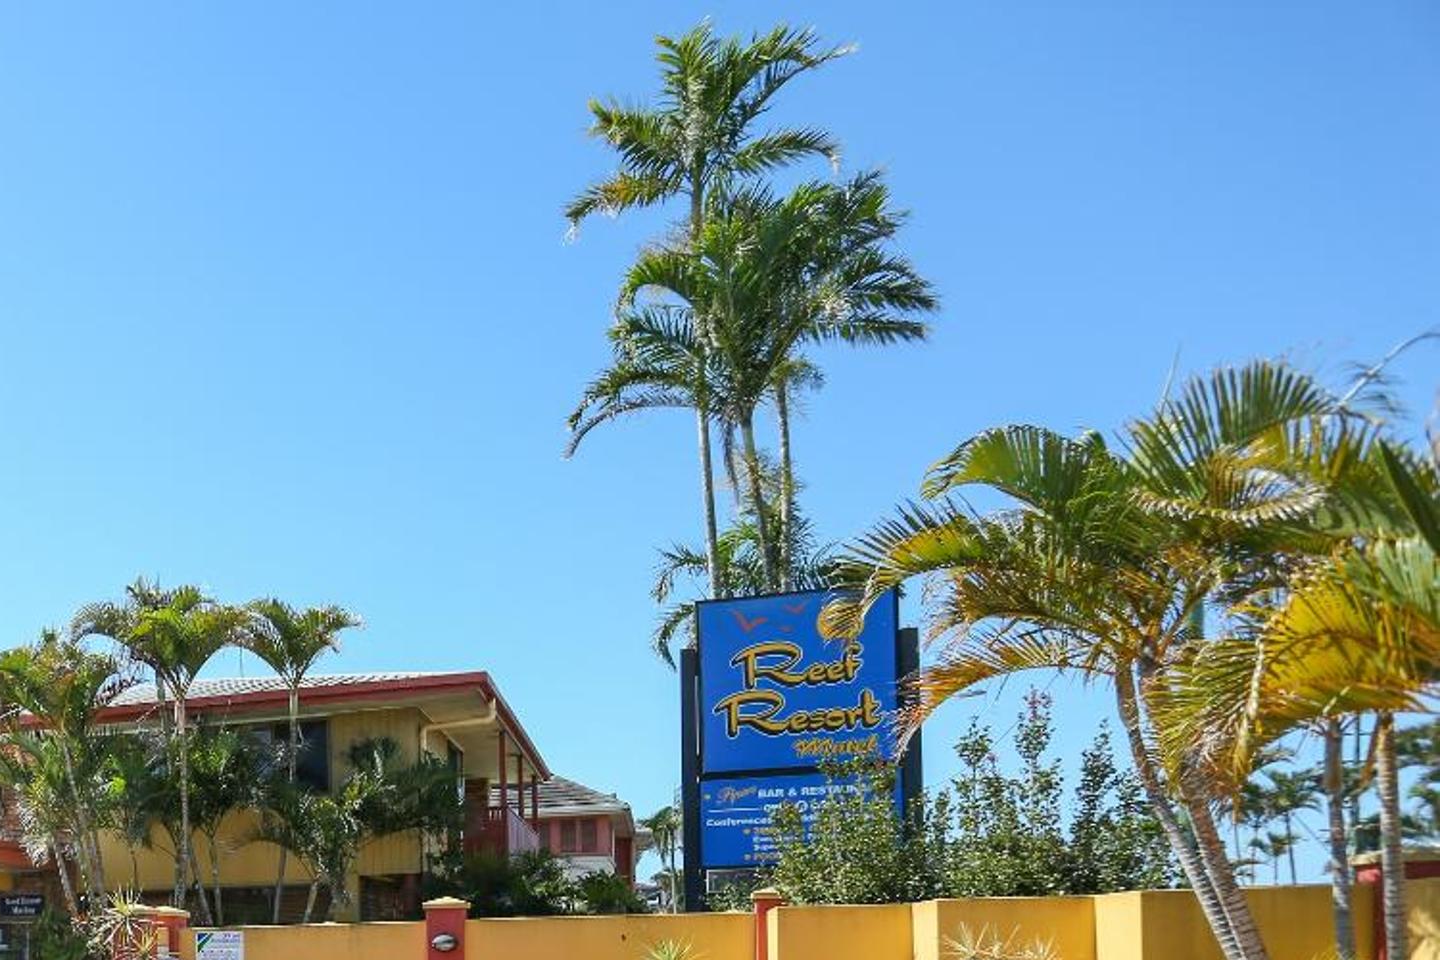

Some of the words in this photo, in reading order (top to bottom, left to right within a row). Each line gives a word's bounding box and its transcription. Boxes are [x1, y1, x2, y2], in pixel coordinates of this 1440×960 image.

[730, 640, 864, 691] Reef
[713, 688, 882, 740] Resort
[758, 788, 785, 799] BAR
[788, 787, 798, 797] &
